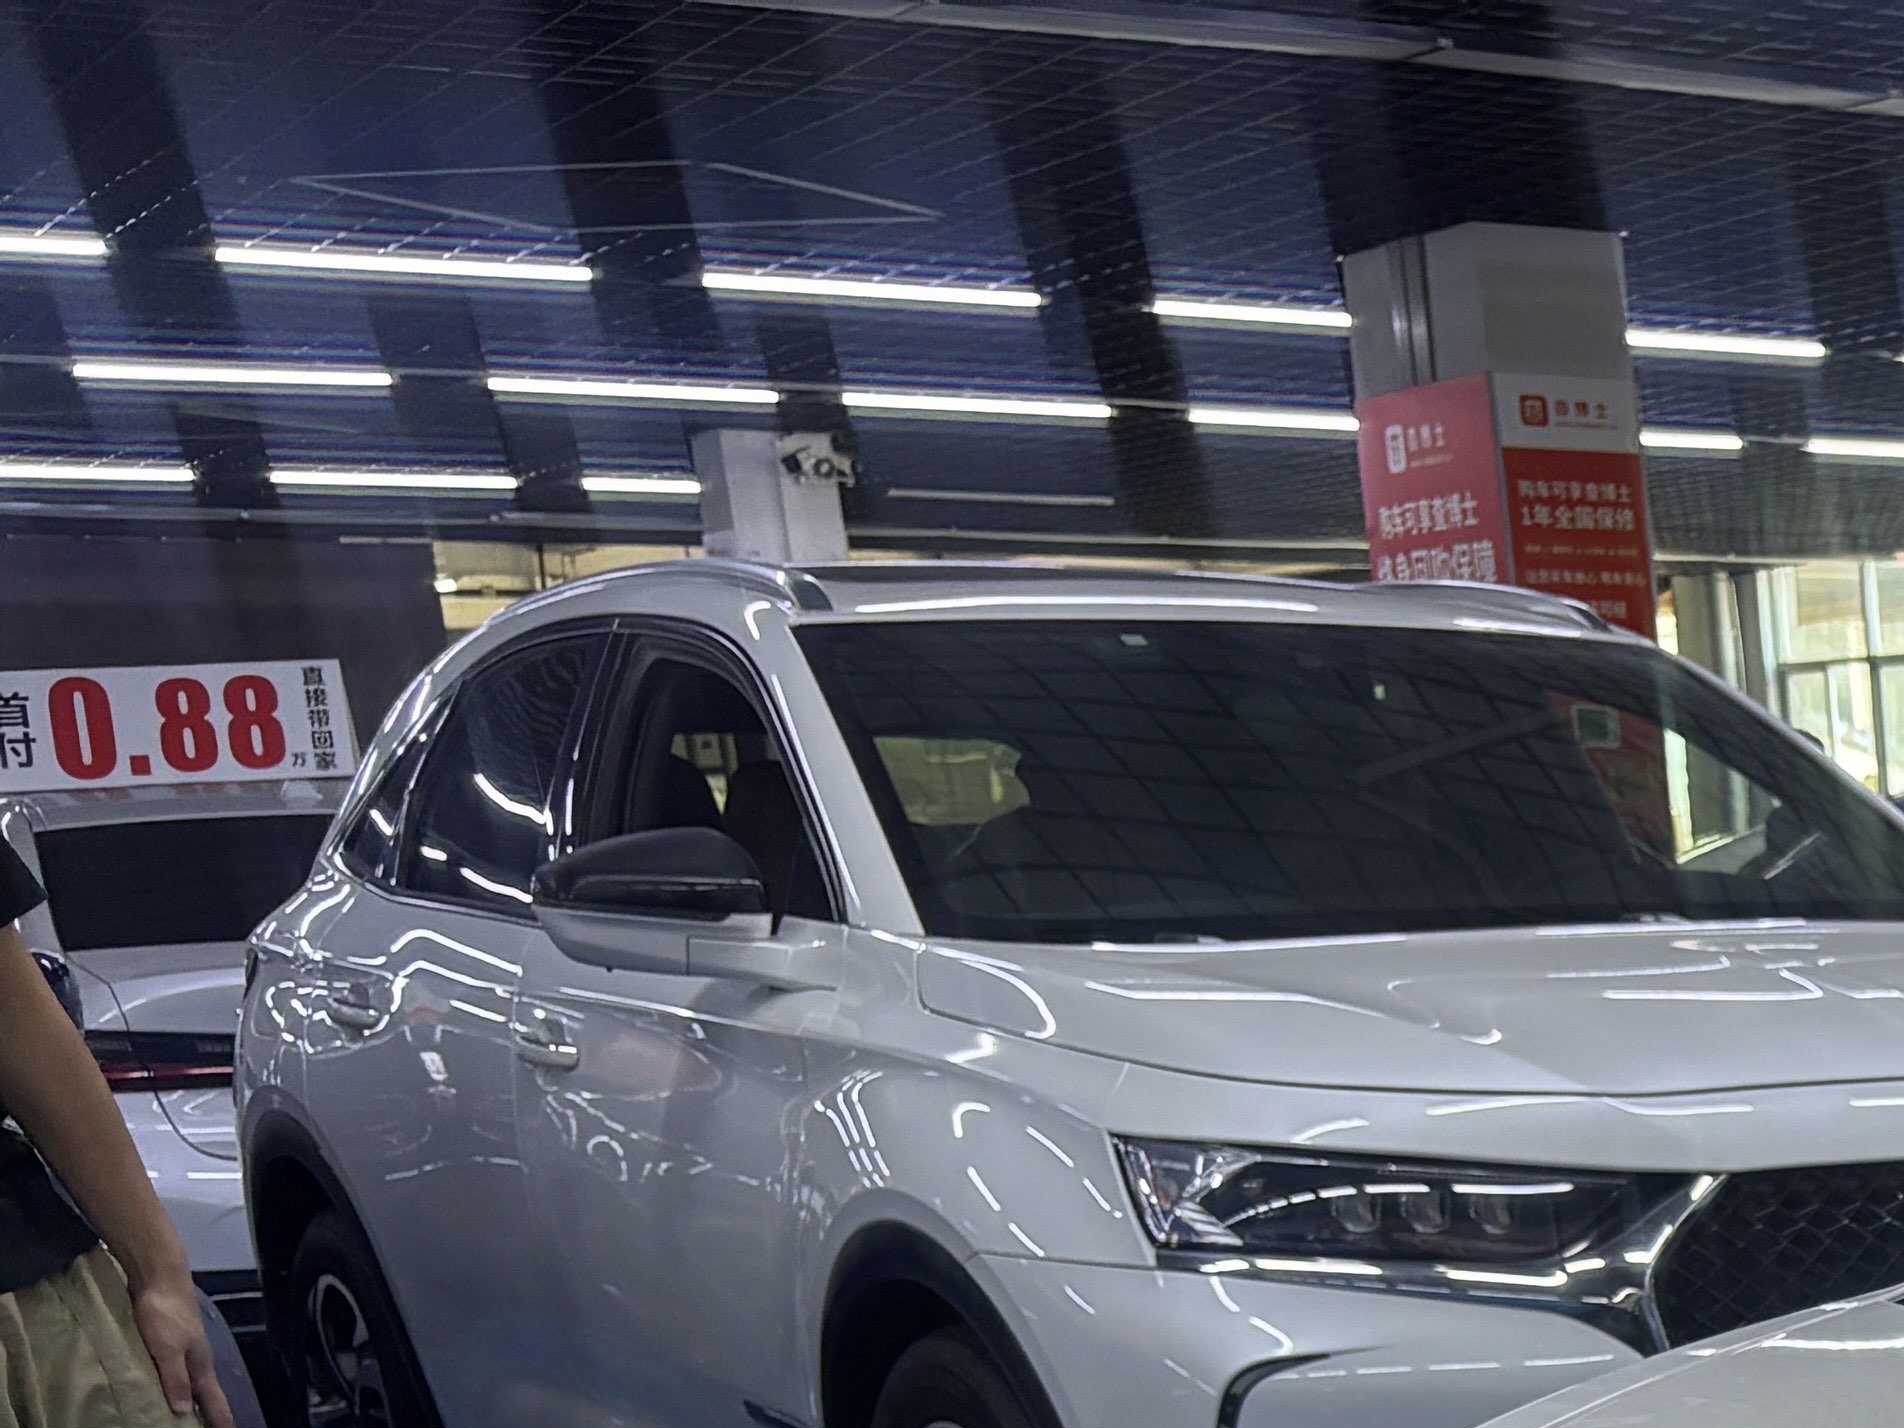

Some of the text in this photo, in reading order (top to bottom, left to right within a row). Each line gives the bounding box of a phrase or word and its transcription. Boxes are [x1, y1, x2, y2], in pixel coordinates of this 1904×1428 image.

[47, 674, 287, 780] 0.88
[303, 666, 338, 772] 直接带回家
